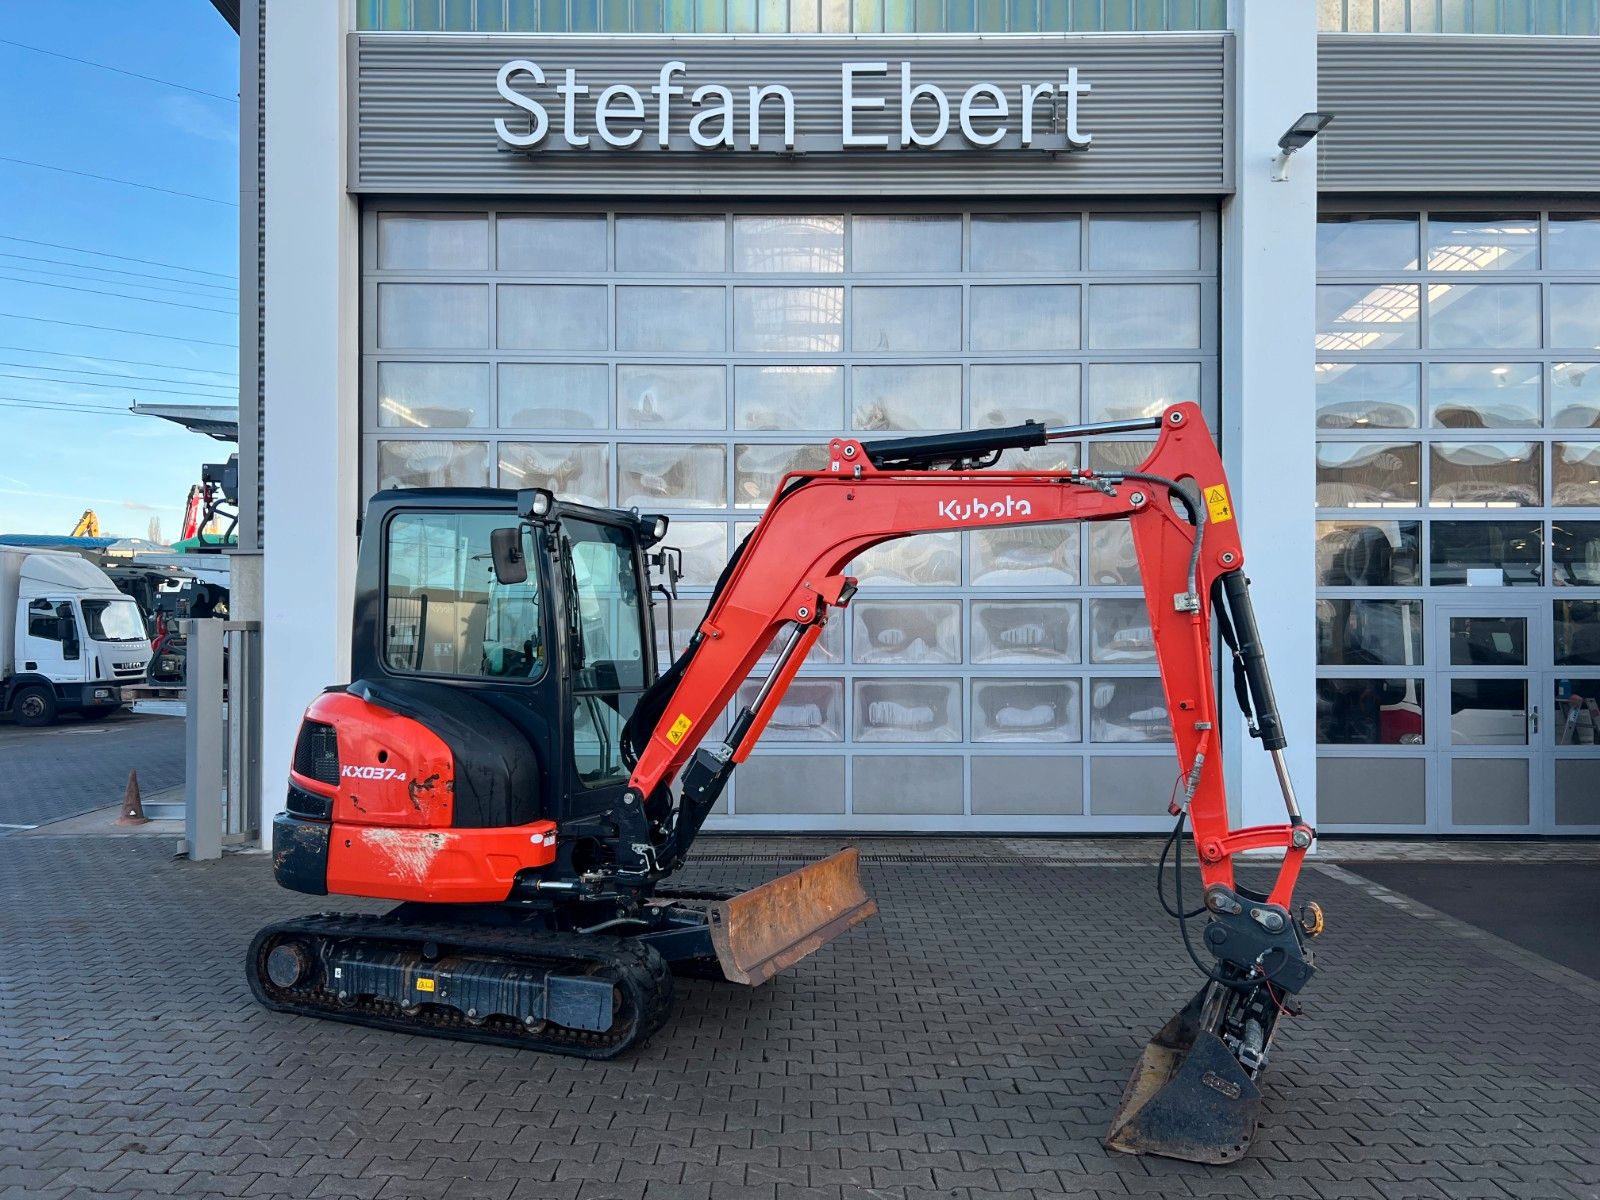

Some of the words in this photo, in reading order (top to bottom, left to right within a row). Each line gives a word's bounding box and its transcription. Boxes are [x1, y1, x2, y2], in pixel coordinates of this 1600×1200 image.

[494, 59, 795, 149] Stefan
[841, 61, 1092, 148] Ebert
[938, 494, 1032, 521] Kubota
[341, 765, 407, 782] KX037-4
